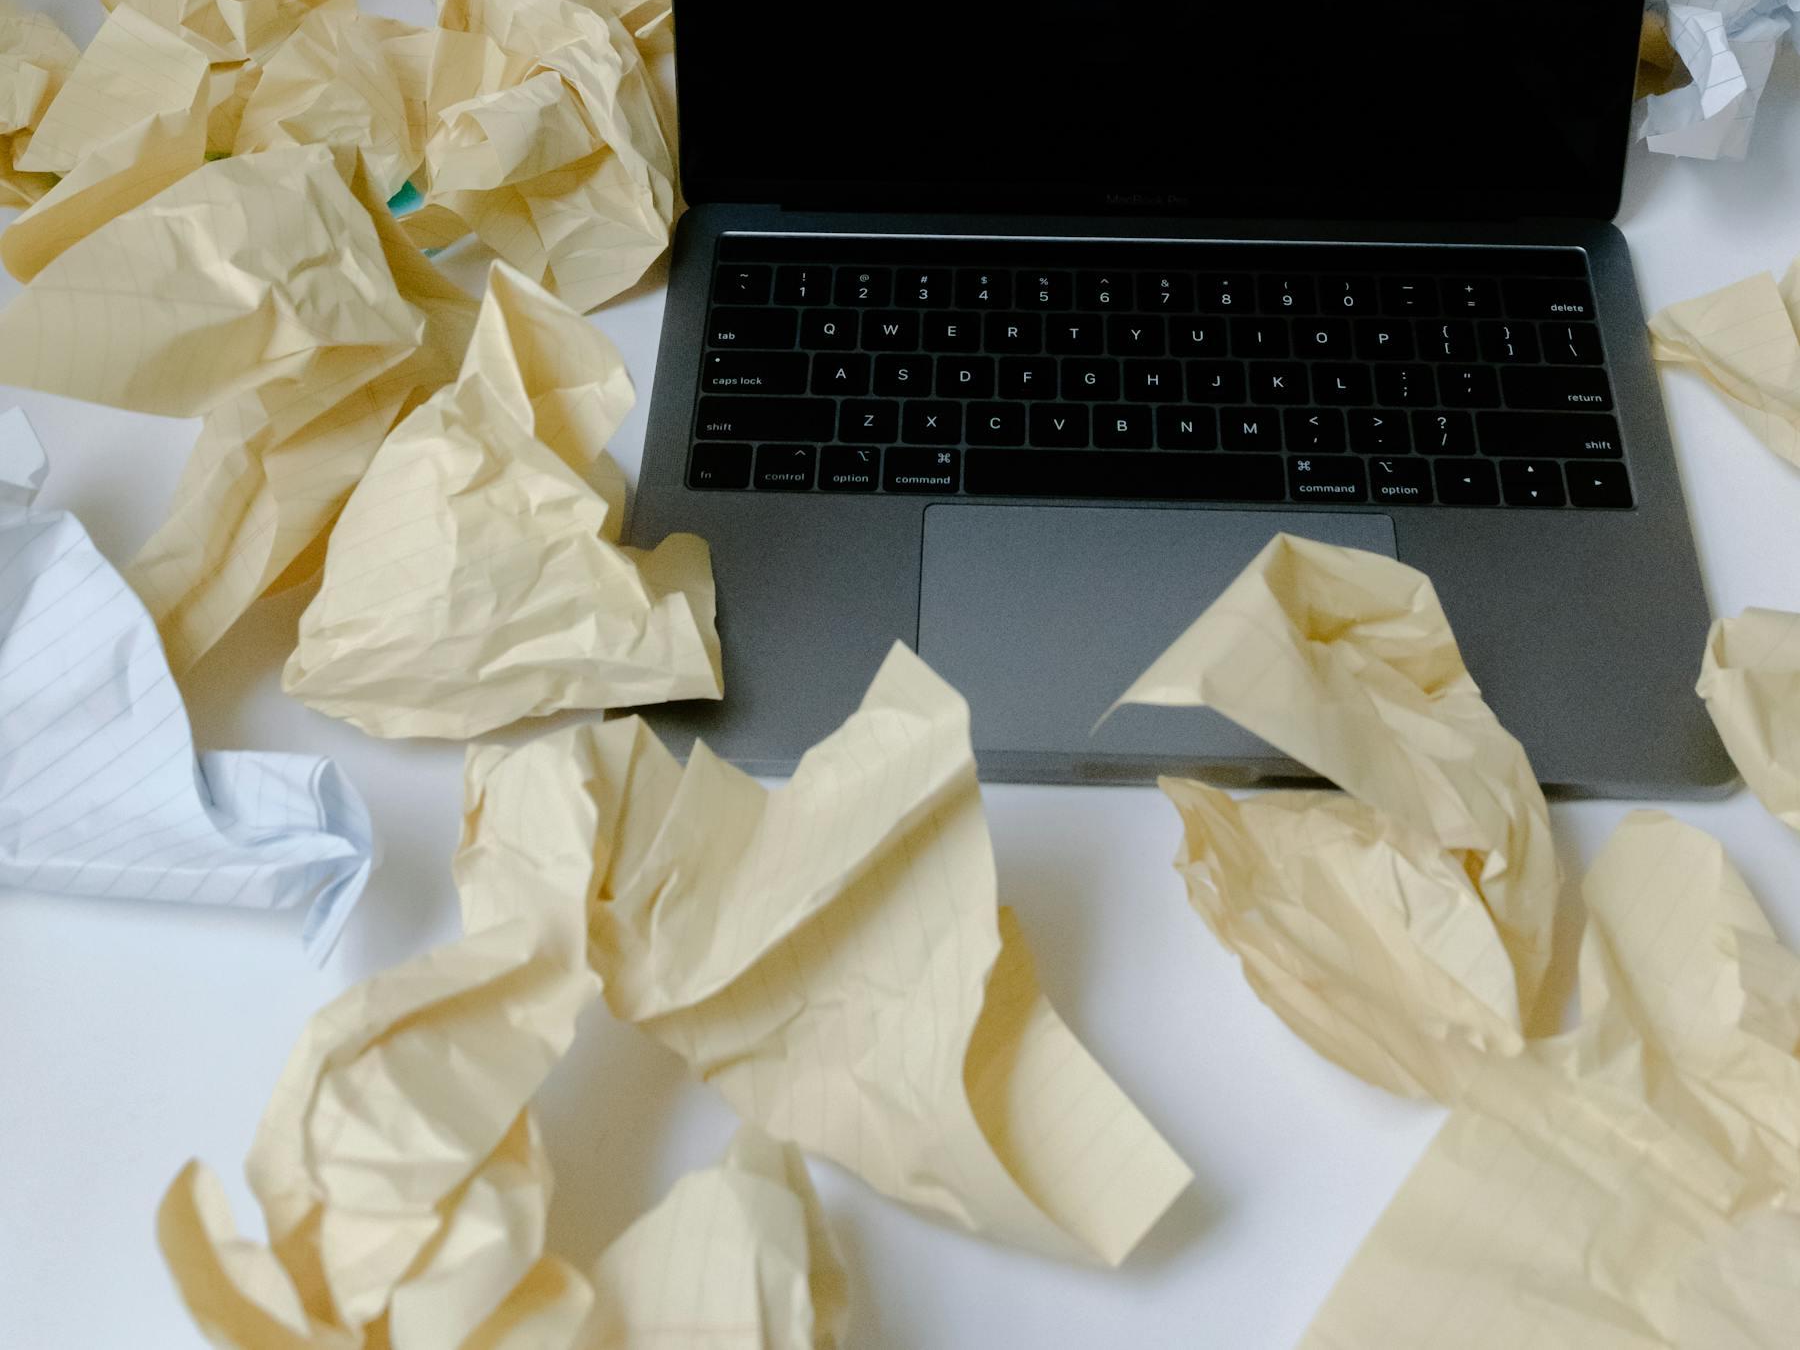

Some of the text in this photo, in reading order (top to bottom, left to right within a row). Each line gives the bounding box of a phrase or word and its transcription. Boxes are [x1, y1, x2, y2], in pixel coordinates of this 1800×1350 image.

[799, 286, 806, 297] 1
[858, 287, 868, 299] 2
[918, 288, 929, 300] 3
[978, 289, 989, 301] 4
[1039, 291, 1049, 302] 5
[1099, 291, 1110, 303] 6
[1161, 292, 1170, 304] 7
[1221, 293, 1232, 305] 8
[1282, 294, 1293, 306] 9
[1550, 303, 1584, 313] delete
[823, 322, 836, 336] Q
[882, 324, 899, 336] W
[947, 325, 957, 337] E
[1007, 326, 1018, 338] R
[1069, 327, 1080, 339] T
[1130, 329, 1142, 341] Y
[718, 331, 736, 340] tab
[1192, 330, 1204, 342] U
[1315, 331, 1328, 344] O
[1378, 333, 1390, 344] P
[835, 367, 847, 379] A
[897, 368, 909, 381] S
[959, 370, 971, 382] D
[1023, 371, 1033, 383] F
[1084, 372, 1096, 385] G
[712, 377, 763, 387] caps lock
[1147, 373, 1159, 386] H
[1211, 375, 1221, 387] J
[1272, 376, 1285, 388] K
[1336, 377, 1347, 389] L
[1567, 394, 1603, 402] return
[706, 422, 732, 431] shift
[863, 414, 875, 427] Z
[926, 416, 937, 428] X
[989, 417, 1001, 430] C
[1053, 418, 1065, 431] V
[1116, 419, 1128, 432] B
[1180, 421, 1193, 433] N
[1243, 422, 1258, 435] M
[1584, 440, 1612, 450] shift
[764, 473, 805, 481] control
[832, 473, 869, 484] option
[895, 475, 951, 485] command
[1299, 484, 1356, 494] command
[1381, 486, 1419, 496] option
